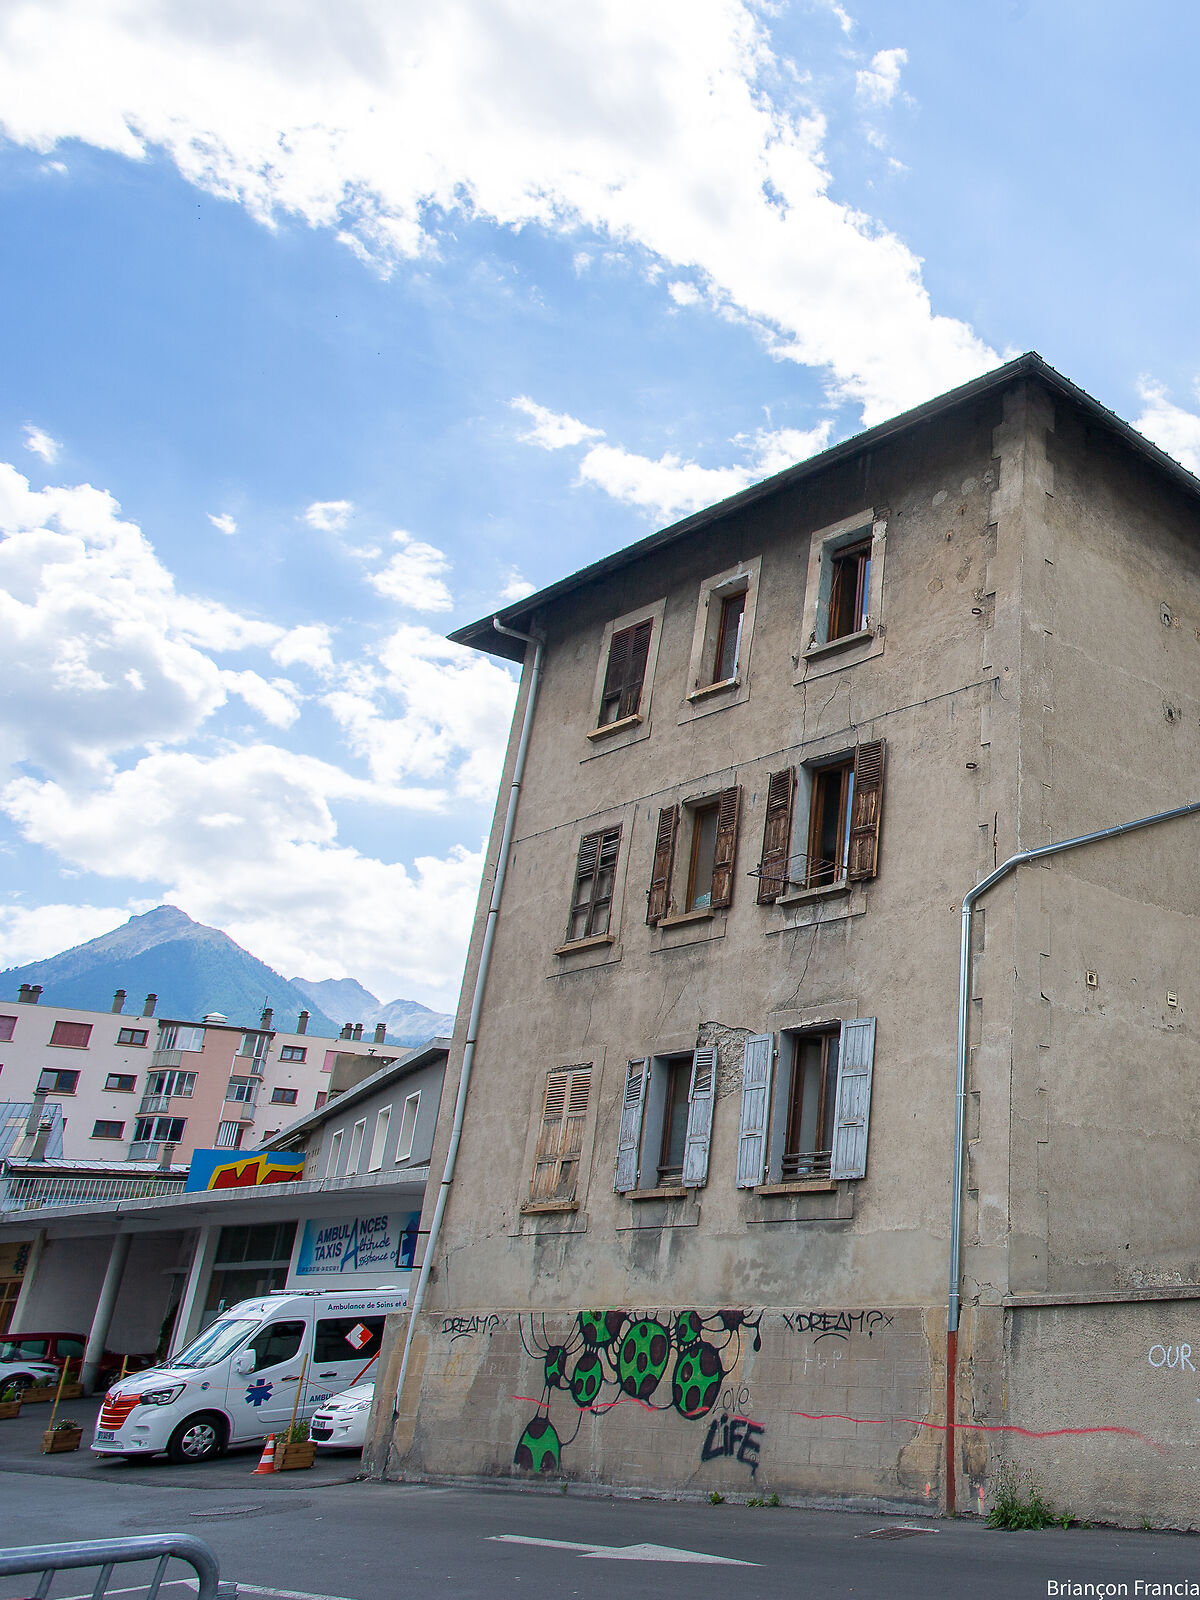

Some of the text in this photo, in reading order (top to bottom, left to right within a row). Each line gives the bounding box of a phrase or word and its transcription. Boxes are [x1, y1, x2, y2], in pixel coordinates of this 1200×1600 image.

[316, 1215, 388, 1246] AMBULANCES
[315, 1241, 342, 1261] TAXIS
[328, 1302, 365, 1310] Ambulance
[1149, 1343, 1196, 1372] OUR
